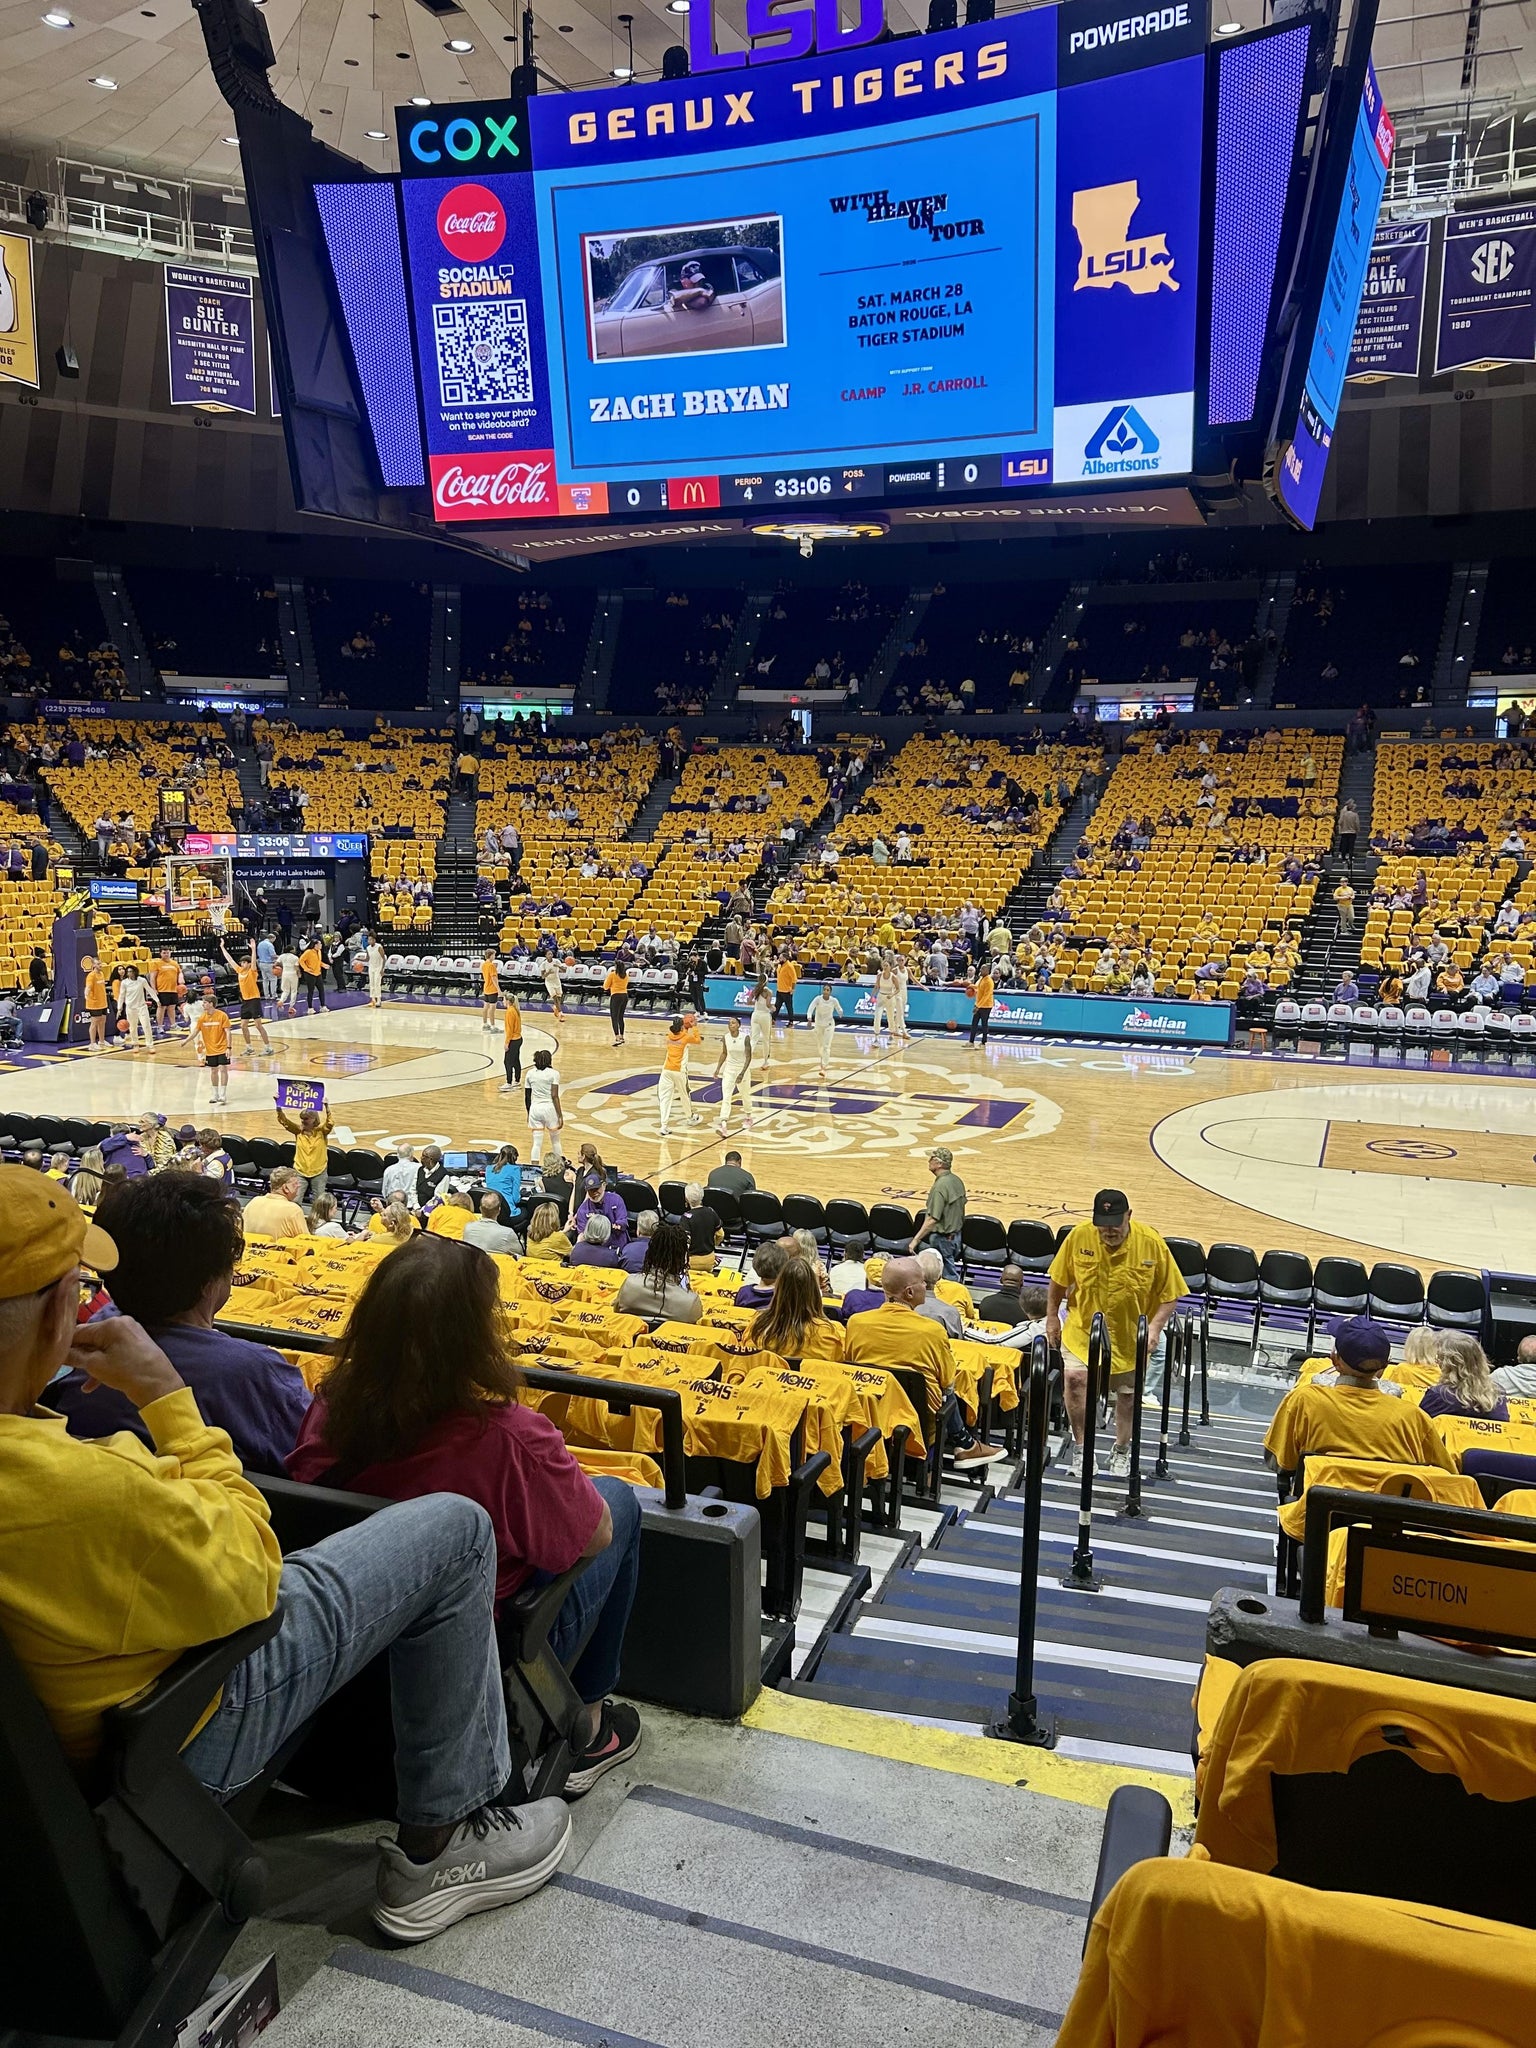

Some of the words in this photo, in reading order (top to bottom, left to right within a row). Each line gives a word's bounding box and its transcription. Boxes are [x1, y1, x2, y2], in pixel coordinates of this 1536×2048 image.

[1069, 3, 1189, 54] POWERADE
[569, 91, 754, 144] GEAUX
[792, 41, 1007, 114] TIGERS
[409, 115, 520, 163] COX
[829, 190, 889, 213] WITH
[867, 193, 948, 223] HEAVEN
[444, 211, 498, 235] Coca-Cola
[1459, 218, 1483, 230] MEN'S
[1486, 212, 1534, 226] BASKETBALL
[932, 219, 985, 241] TOUR
[1373, 230, 1416, 241] ASKETBALL
[1087, 247, 1147, 278] LSU
[1471, 240, 1515, 284] SEC
[171, 272, 204, 283] WOMEN'S
[205, 277, 246, 290] BASKETBALL
[438, 265, 500, 283] SOCIAL
[1364, 265, 1397, 281] ALE
[439, 280, 512, 298] STADIUM
[857, 294, 886, 309] SAT.
[890, 286, 940, 305] MARCH
[945, 283, 963, 297] 28
[1450, 294, 1492, 305] TOURNAMENT
[1494, 289, 1532, 300] CHAMPIONS
[199, 297, 221, 306] COACH
[1377, 305, 1398, 313] FOURS
[196, 305, 224, 321] SUE
[849, 311, 896, 328] BATON
[900, 304, 951, 322] ROUGE,
[954, 301, 973, 315] LA
[1360, 317, 1372, 325] SEC
[1374, 315, 1394, 324] TITLES
[182, 317, 239, 336] GUNTER
[1364, 323, 1410, 334] TOURNAMENTS
[1452, 320, 1471, 330] 1980
[857, 332, 899, 348] TIGER
[902, 323, 965, 343] STADIUM
[1365, 335, 1395, 344] NATIONAL
[206, 343, 220, 351] HALL
[221, 344, 228, 352] OF
[229, 346, 245, 354] FAME
[1386, 342, 1402, 350] YEAR
[198, 351, 214, 359] FINAL
[1370, 354, 1387, 362] WINS
[211, 361, 230, 369] TITLES
[185, 373, 203, 382] COACH
[205, 375, 212, 383] OF
[213, 377, 224, 385] THE
[225, 378, 240, 386] YEAR
[840, 386, 886, 402] CAAMP
[902, 383, 924, 396] J.R.
[928, 375, 988, 393] CARROLL
[589, 393, 676, 422] ZACH
[682, 383, 789, 416] BRYAN
[440, 412, 463, 421] Want
[465, 412, 474, 420] to
[475, 411, 490, 419] see
[491, 410, 511, 420] your
[512, 408, 537, 418] photo
[449, 423, 461, 431] on
[462, 421, 476, 430] the
[477, 418, 529, 429] videoboard?
[964, 464, 978, 482] 0
[1007, 459, 1048, 477] LSU
[1082, 456, 1159, 475] Albertsons
[735, 477, 762, 486] PERIOD
[843, 470, 865, 478] POSS.
[889, 472, 931, 483] POWERADE
[436, 462, 551, 507] Coca-Cola
[775, 476, 831, 497] 33:06
[627, 488, 640, 506] 0
[744, 487, 753, 500] 4
[905, 510, 1021, 519] GLOBAL
[1027, 505, 1169, 516] VENTURE
[512, 534, 627, 550] VENTURE
[629, 524, 732, 539] GLOBAL
[258, 837, 289, 847] 33:06
[320, 845, 328, 856] 0
[236, 869, 249, 877] Our
[250, 869, 265, 878] Lady
[265, 869, 275, 877] of
[275, 869, 287, 877] the
[288, 869, 302, 877] Lake
[304, 869, 326, 877] Health
[988, 1017, 1017, 1025] mbulance
[1122, 1013, 1187, 1030] Acadian
[1123, 1026, 1159, 1034] Ambulance
[1161, 1027, 1186, 1035] Service
[1018, 1055, 1196, 1076] COX
[286, 1086, 319, 1100] Purple
[285, 1096, 315, 1109] Reign
[1080, 1248, 1094, 1256] LSU
[579, 1312, 604, 1324] SHOW
[777, 1372, 815, 1389] SHOW
[852, 1371, 886, 1385] SHOW
[690, 1381, 733, 1399] SHOW
[695, 1403, 707, 1415] 4
[737, 1412, 744, 1420] 1
[1470, 1420, 1502, 1434] SHOW
[1392, 1574, 1468, 1605] SECTION
[430, 1861, 488, 1888] HOKA
